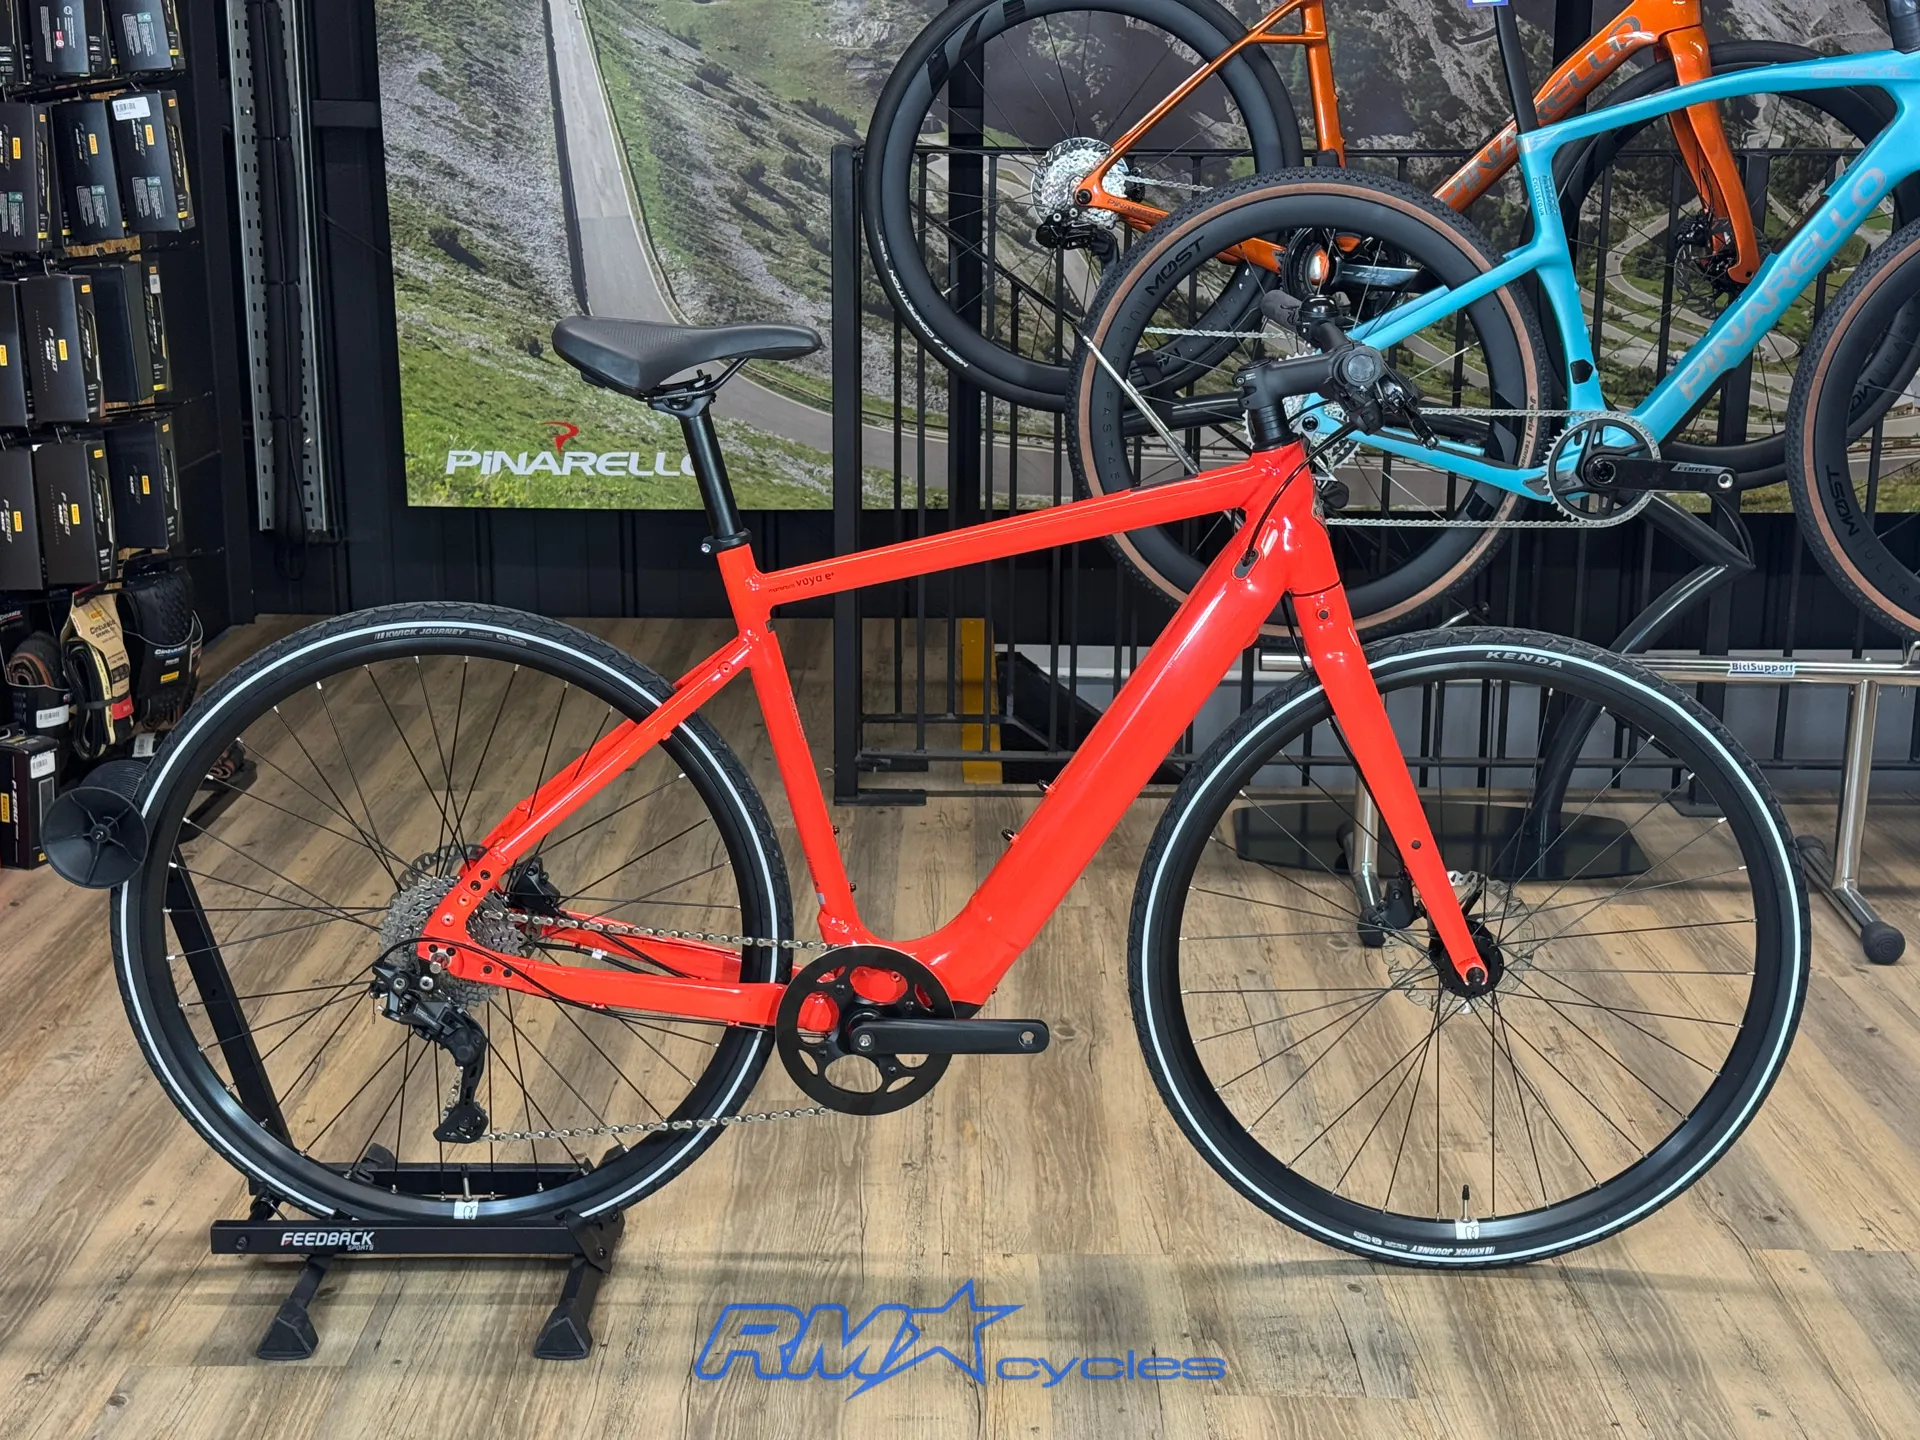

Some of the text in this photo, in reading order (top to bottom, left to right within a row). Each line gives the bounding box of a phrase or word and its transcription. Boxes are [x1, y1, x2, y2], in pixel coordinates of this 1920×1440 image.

[1679, 167, 1887, 401] PINARELLO
[888, 269, 936, 338] COMPETITION
[795, 575, 823, 587] voya
[385, 628, 417, 638] KWICK
[419, 628, 466, 636] JOURNEY
[1485, 651, 1562, 668] KENDA
[1732, 662, 1794, 674] BiciSupport
[280, 1232, 375, 1246] FEEDBACK
